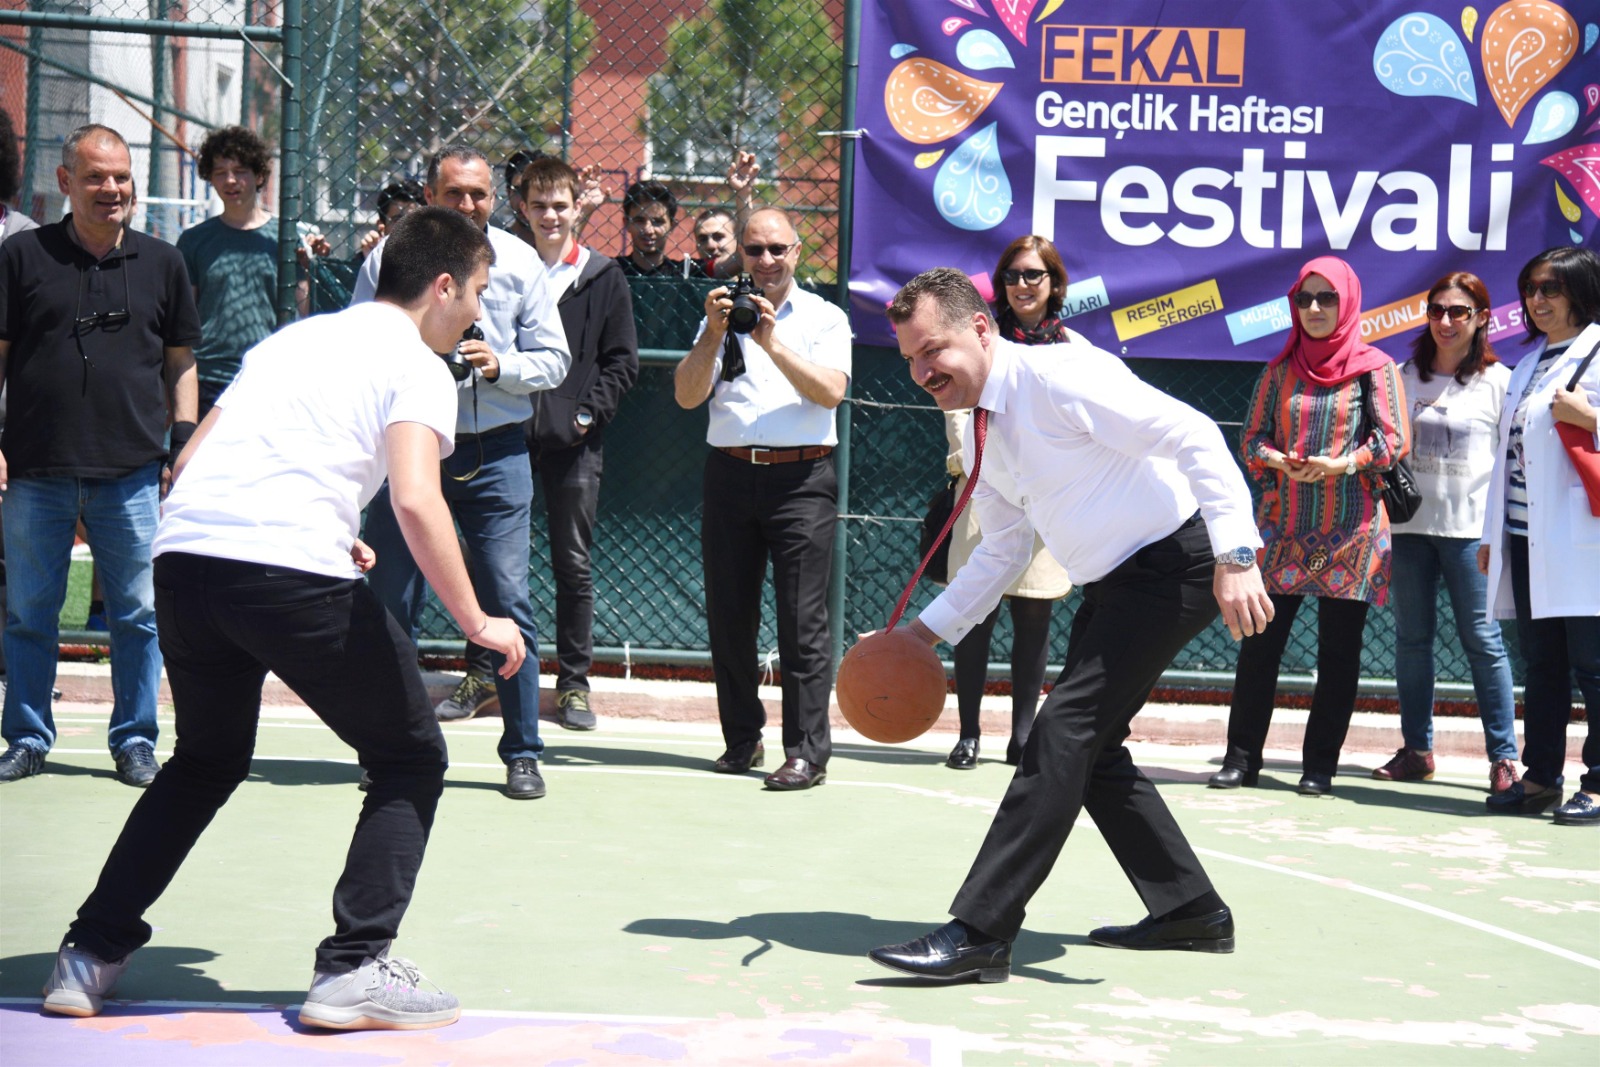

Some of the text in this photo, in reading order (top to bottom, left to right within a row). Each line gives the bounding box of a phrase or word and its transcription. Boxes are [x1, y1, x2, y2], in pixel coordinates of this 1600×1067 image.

[1043, 26, 1241, 85] FEKAL
[1035, 90, 1324, 139] Gençlik Haftası
[1031, 135, 1514, 252] Festivali
[1058, 294, 1103, 319] DLARI
[1126, 297, 1175, 323] RESİM
[1157, 296, 1217, 328] SERGİSİ
[1239, 302, 1284, 328] MÜZİK
